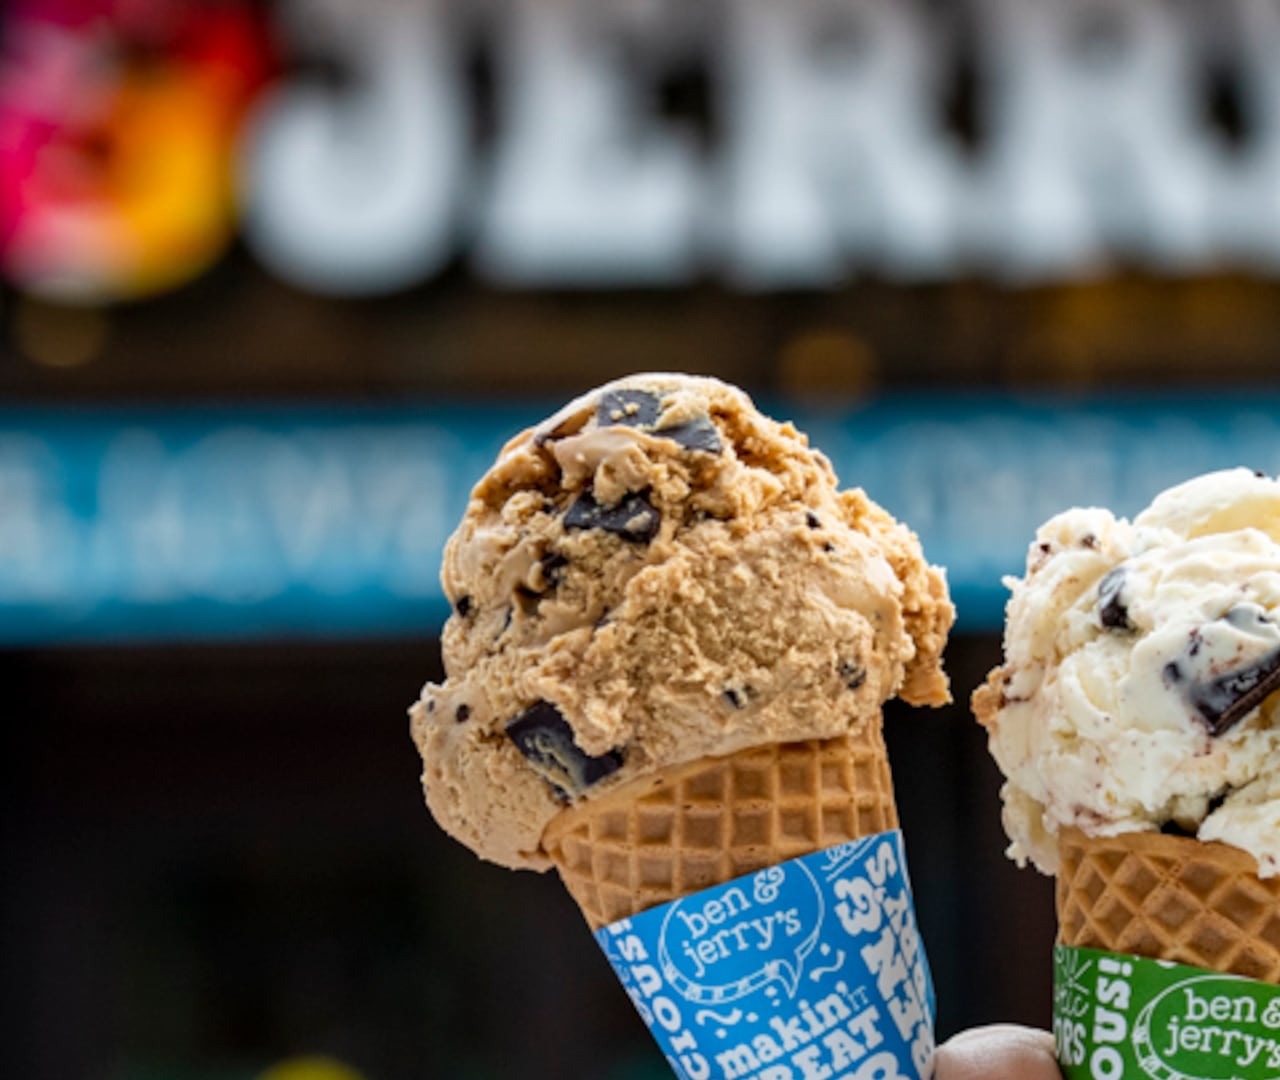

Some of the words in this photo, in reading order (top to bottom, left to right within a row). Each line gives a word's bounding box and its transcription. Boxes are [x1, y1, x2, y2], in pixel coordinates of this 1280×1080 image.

[677, 886, 751, 940] ben
[753, 865, 785, 902] &
[682, 907, 802, 978] jerry's
[715, 980, 848, 1080] makin'
[1184, 987, 1256, 1023] ben
